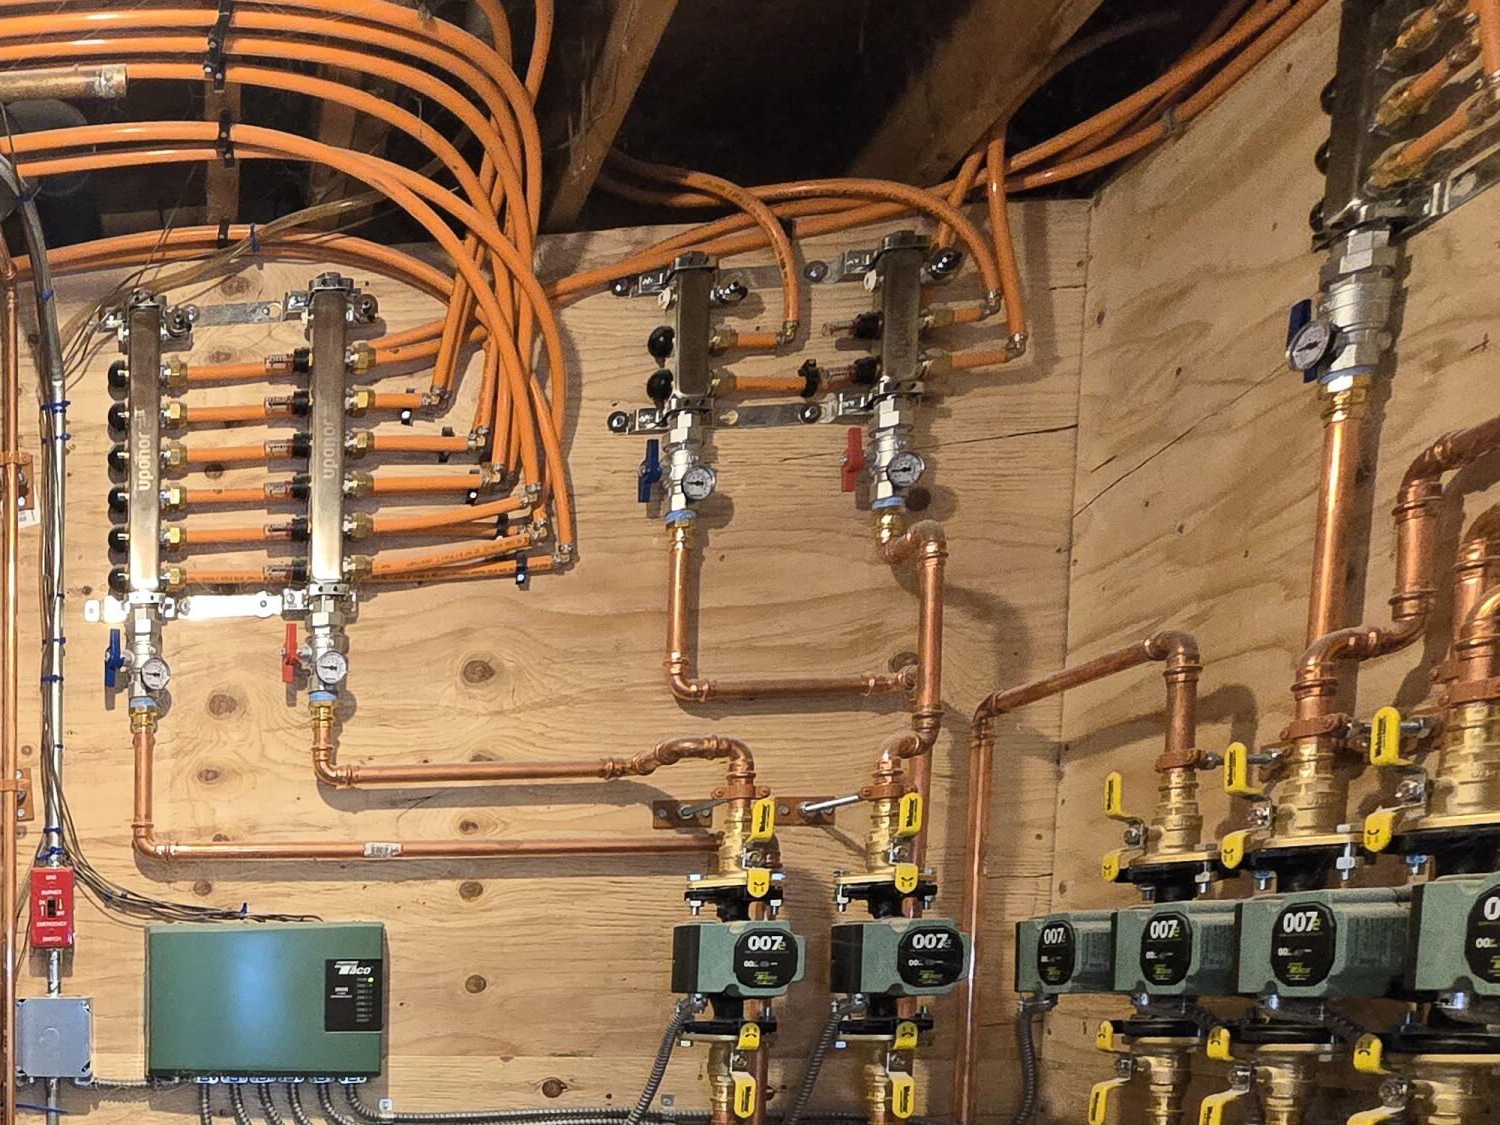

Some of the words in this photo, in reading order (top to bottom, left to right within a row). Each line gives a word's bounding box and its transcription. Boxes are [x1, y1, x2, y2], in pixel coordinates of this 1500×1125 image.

[137, 431, 154, 491] uponor
[323, 419, 340, 479] uponor
[747, 935, 787, 951] 007e
[1283, 912, 1321, 934] 007e
